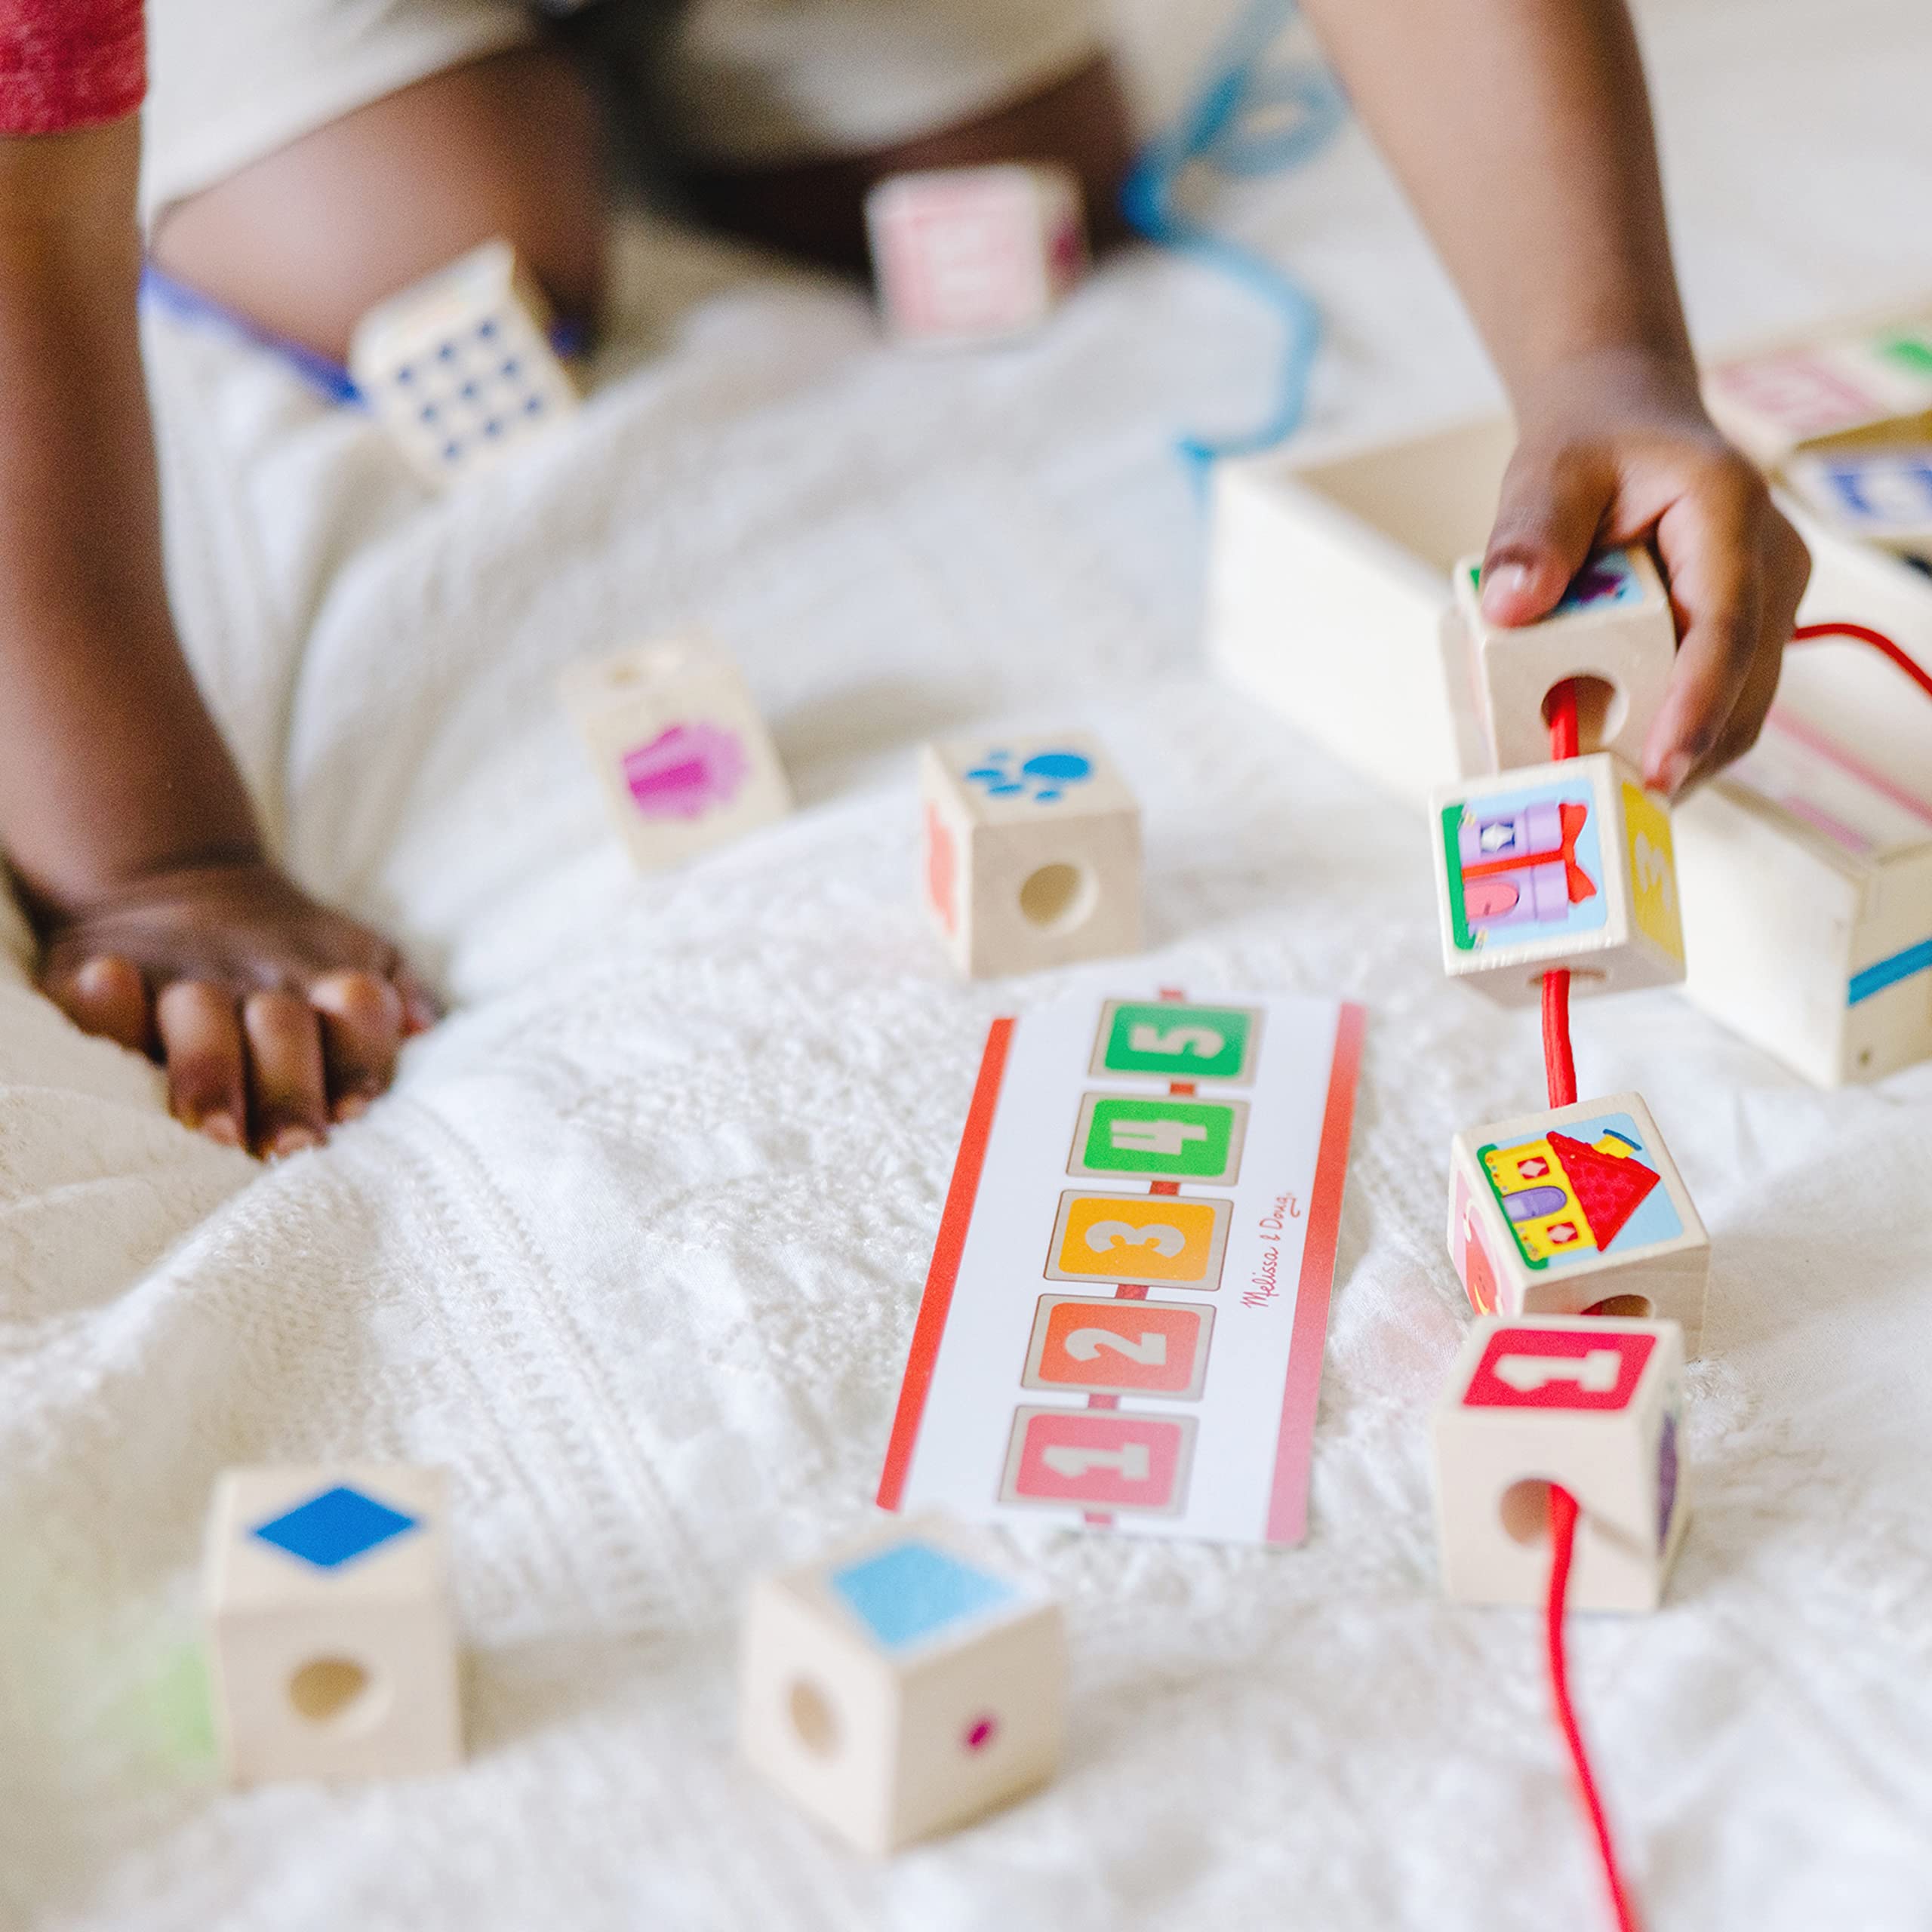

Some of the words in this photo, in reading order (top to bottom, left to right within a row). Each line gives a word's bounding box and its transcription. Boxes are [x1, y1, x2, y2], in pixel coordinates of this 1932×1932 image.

[1635, 831, 1672, 912] 3
[1129, 1023, 1224, 1058] 5
[1110, 1118, 1208, 1155] 4
[1084, 1220, 1186, 1258] 3
[1240, 1247, 1280, 1309] Melissa
[1064, 1327, 1167, 1365] 2
[1494, 1348, 1623, 1394] 1
[1041, 1442, 1149, 1481] 1
